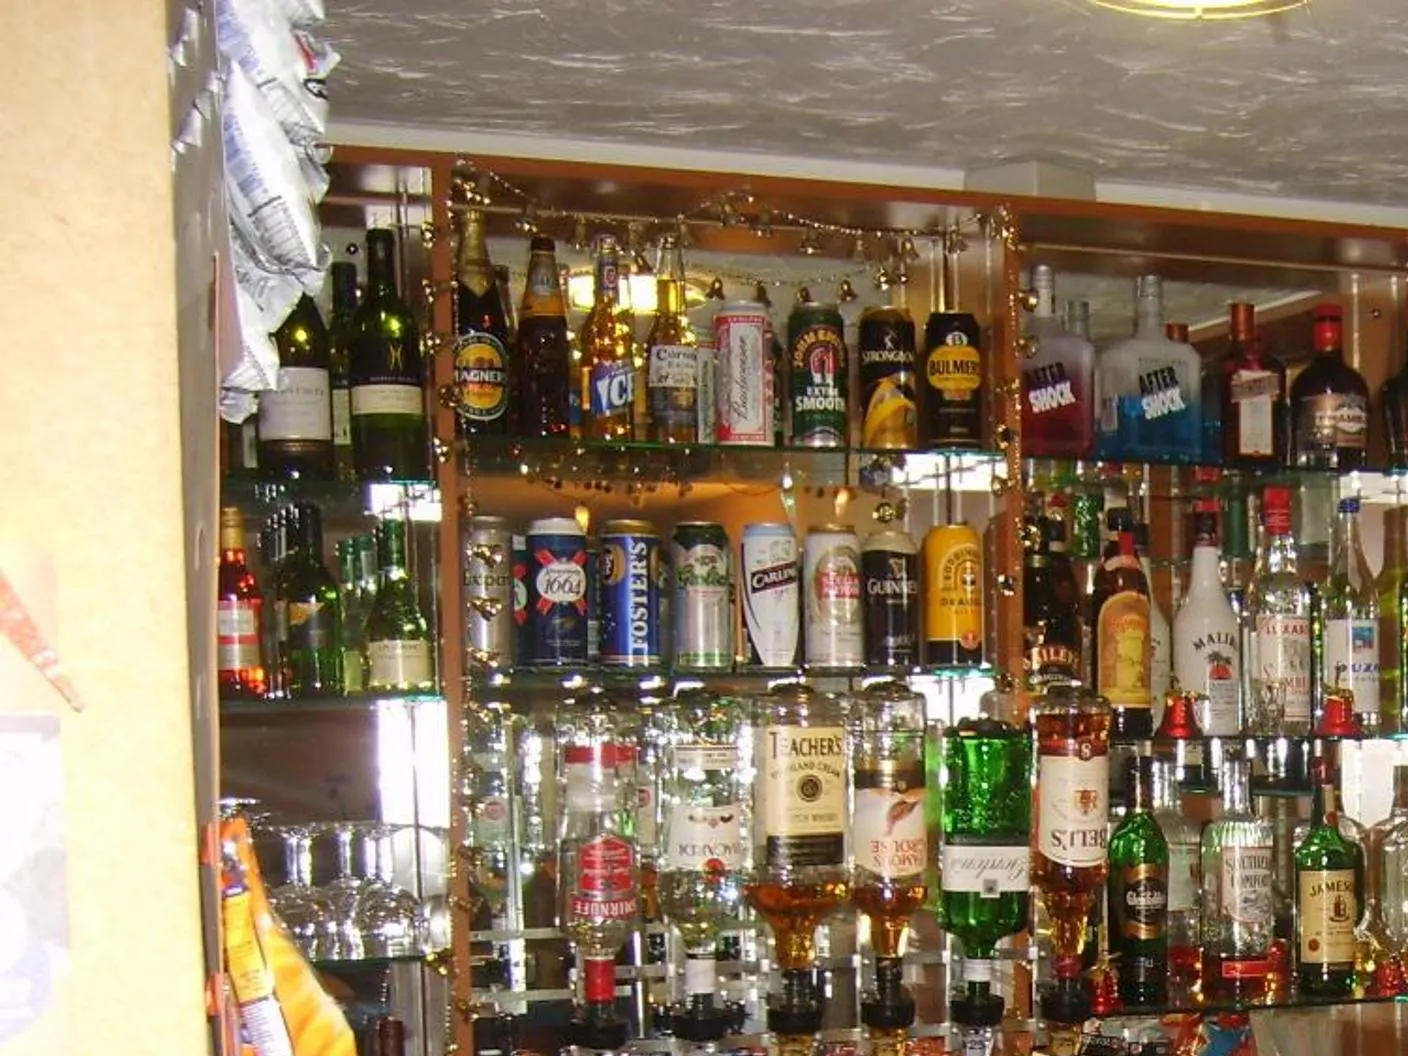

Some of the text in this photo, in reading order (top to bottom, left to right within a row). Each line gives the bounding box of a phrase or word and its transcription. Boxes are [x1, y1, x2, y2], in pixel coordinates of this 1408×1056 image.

[1138, 365, 1178, 395] AFTER
[1028, 379, 1077, 414] SHOCK
[1142, 385, 1188, 420] SHOCK
[543, 576, 582, 595] 1664
[768, 731, 842, 760] TEACHER'S
[954, 855, 1029, 881] Gordon's
